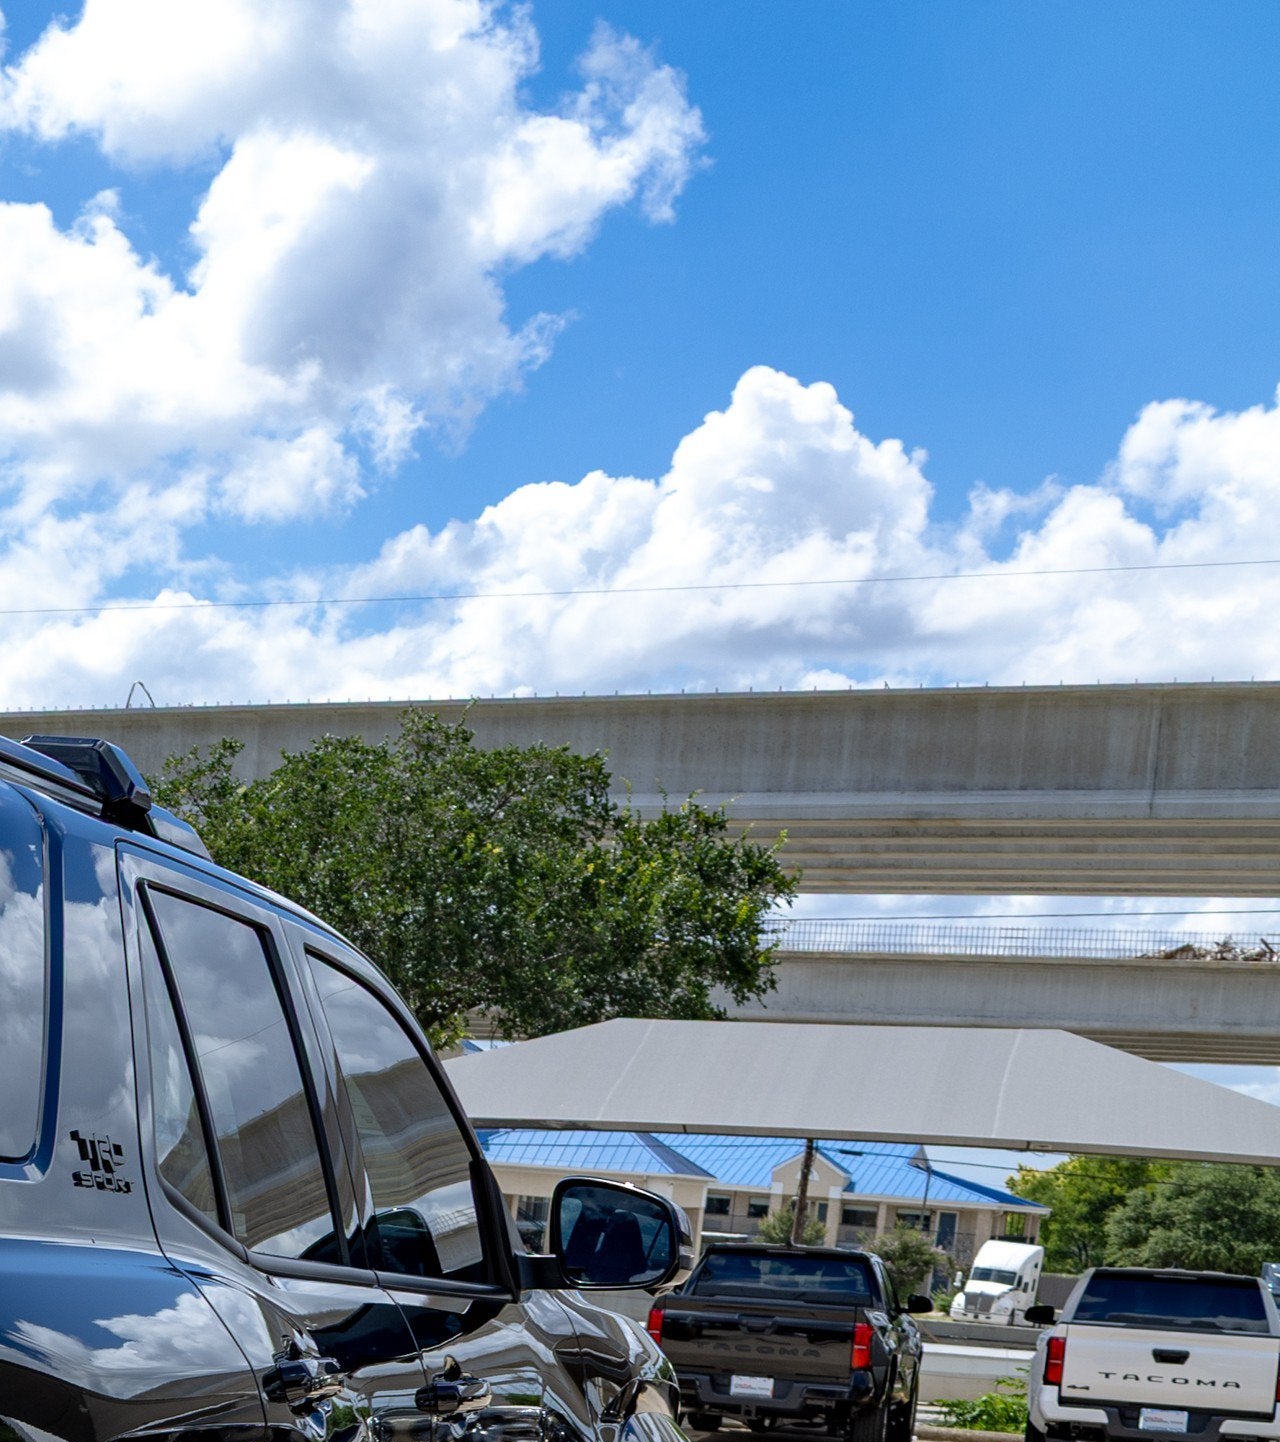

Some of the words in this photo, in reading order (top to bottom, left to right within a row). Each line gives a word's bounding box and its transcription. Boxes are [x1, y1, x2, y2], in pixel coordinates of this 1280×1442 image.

[71, 1171, 134, 1193] SPORT
[692, 1340, 821, 1358] TACOMA
[1098, 1371, 1241, 1389] TACOMA
